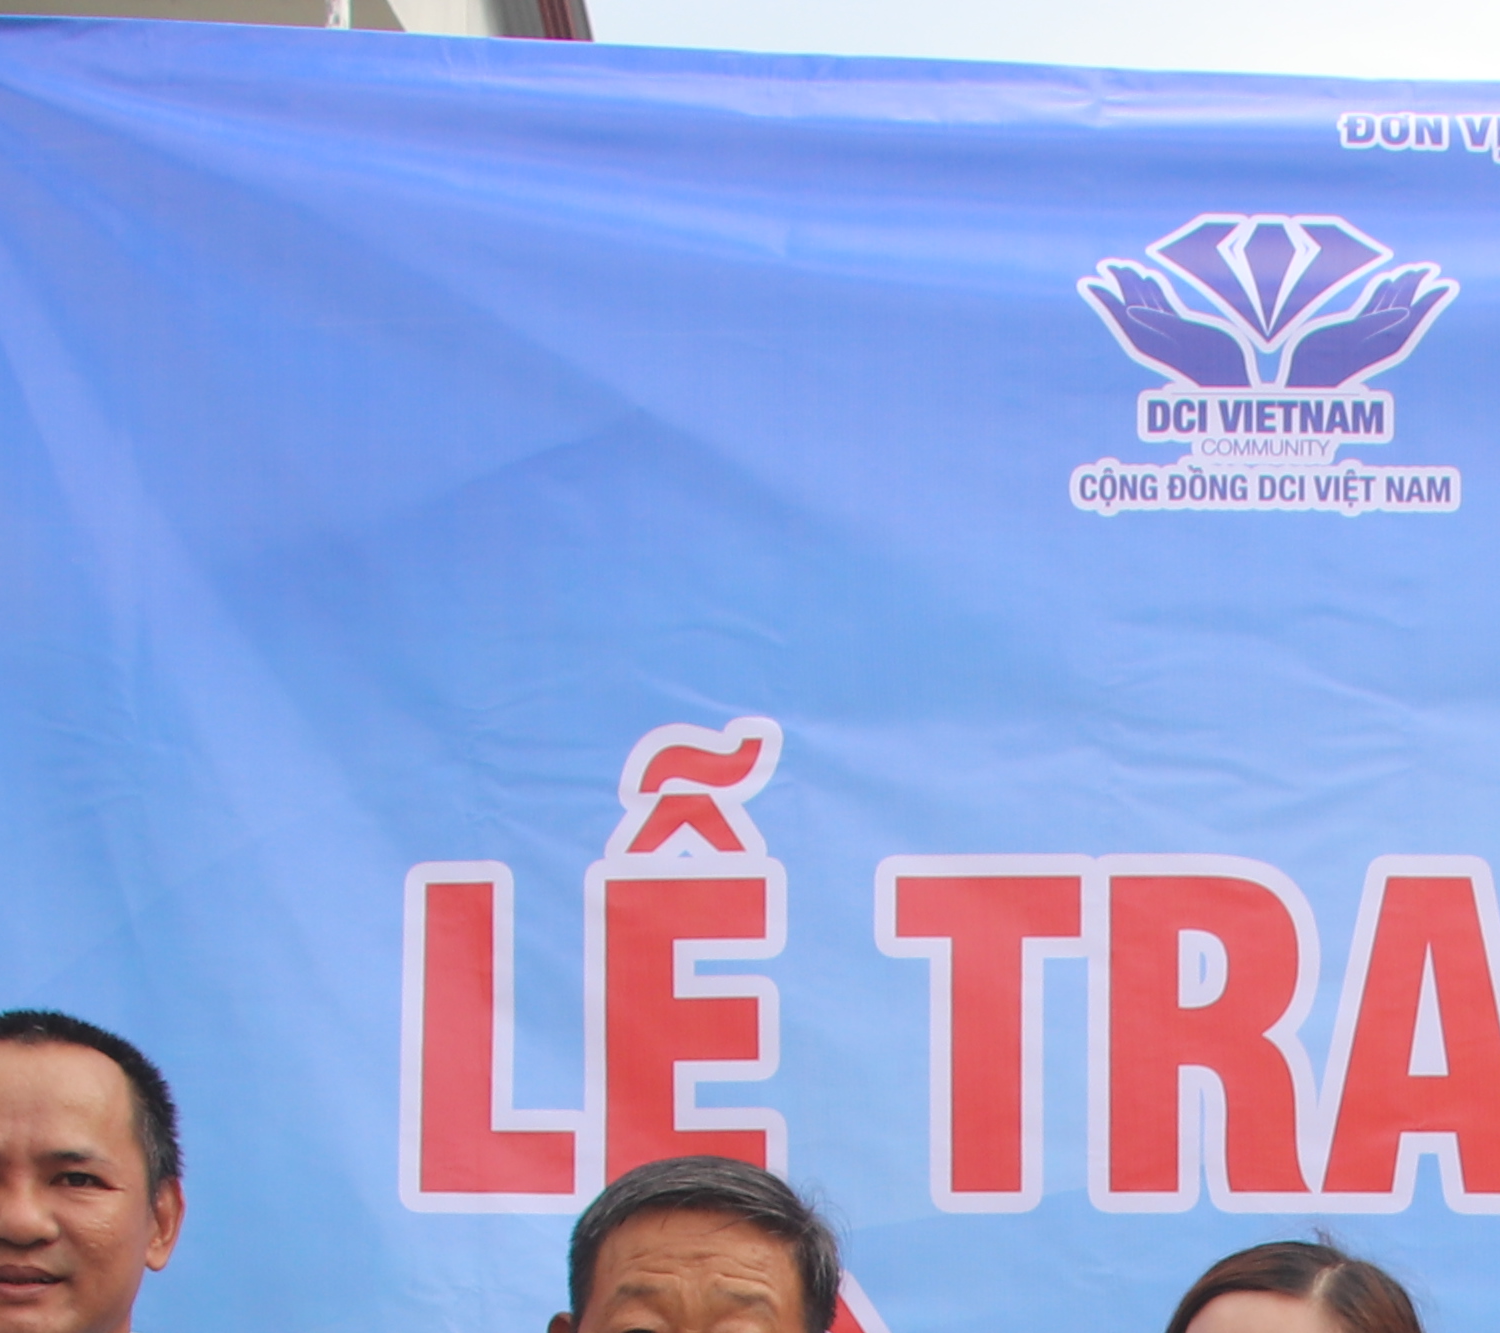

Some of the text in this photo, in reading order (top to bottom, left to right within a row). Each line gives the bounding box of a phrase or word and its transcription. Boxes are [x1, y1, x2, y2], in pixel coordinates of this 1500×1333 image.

[1341, 113, 1440, 146] ĐƠN
[1147, 400, 1384, 435] DCI VIETNAM
[1201, 439, 1330, 458] COMMUNITY
[1080, 463, 1452, 510] CỘNG ĐỒNG DCI VIỆT NAM
[418, 738, 768, 1194] LỄ
